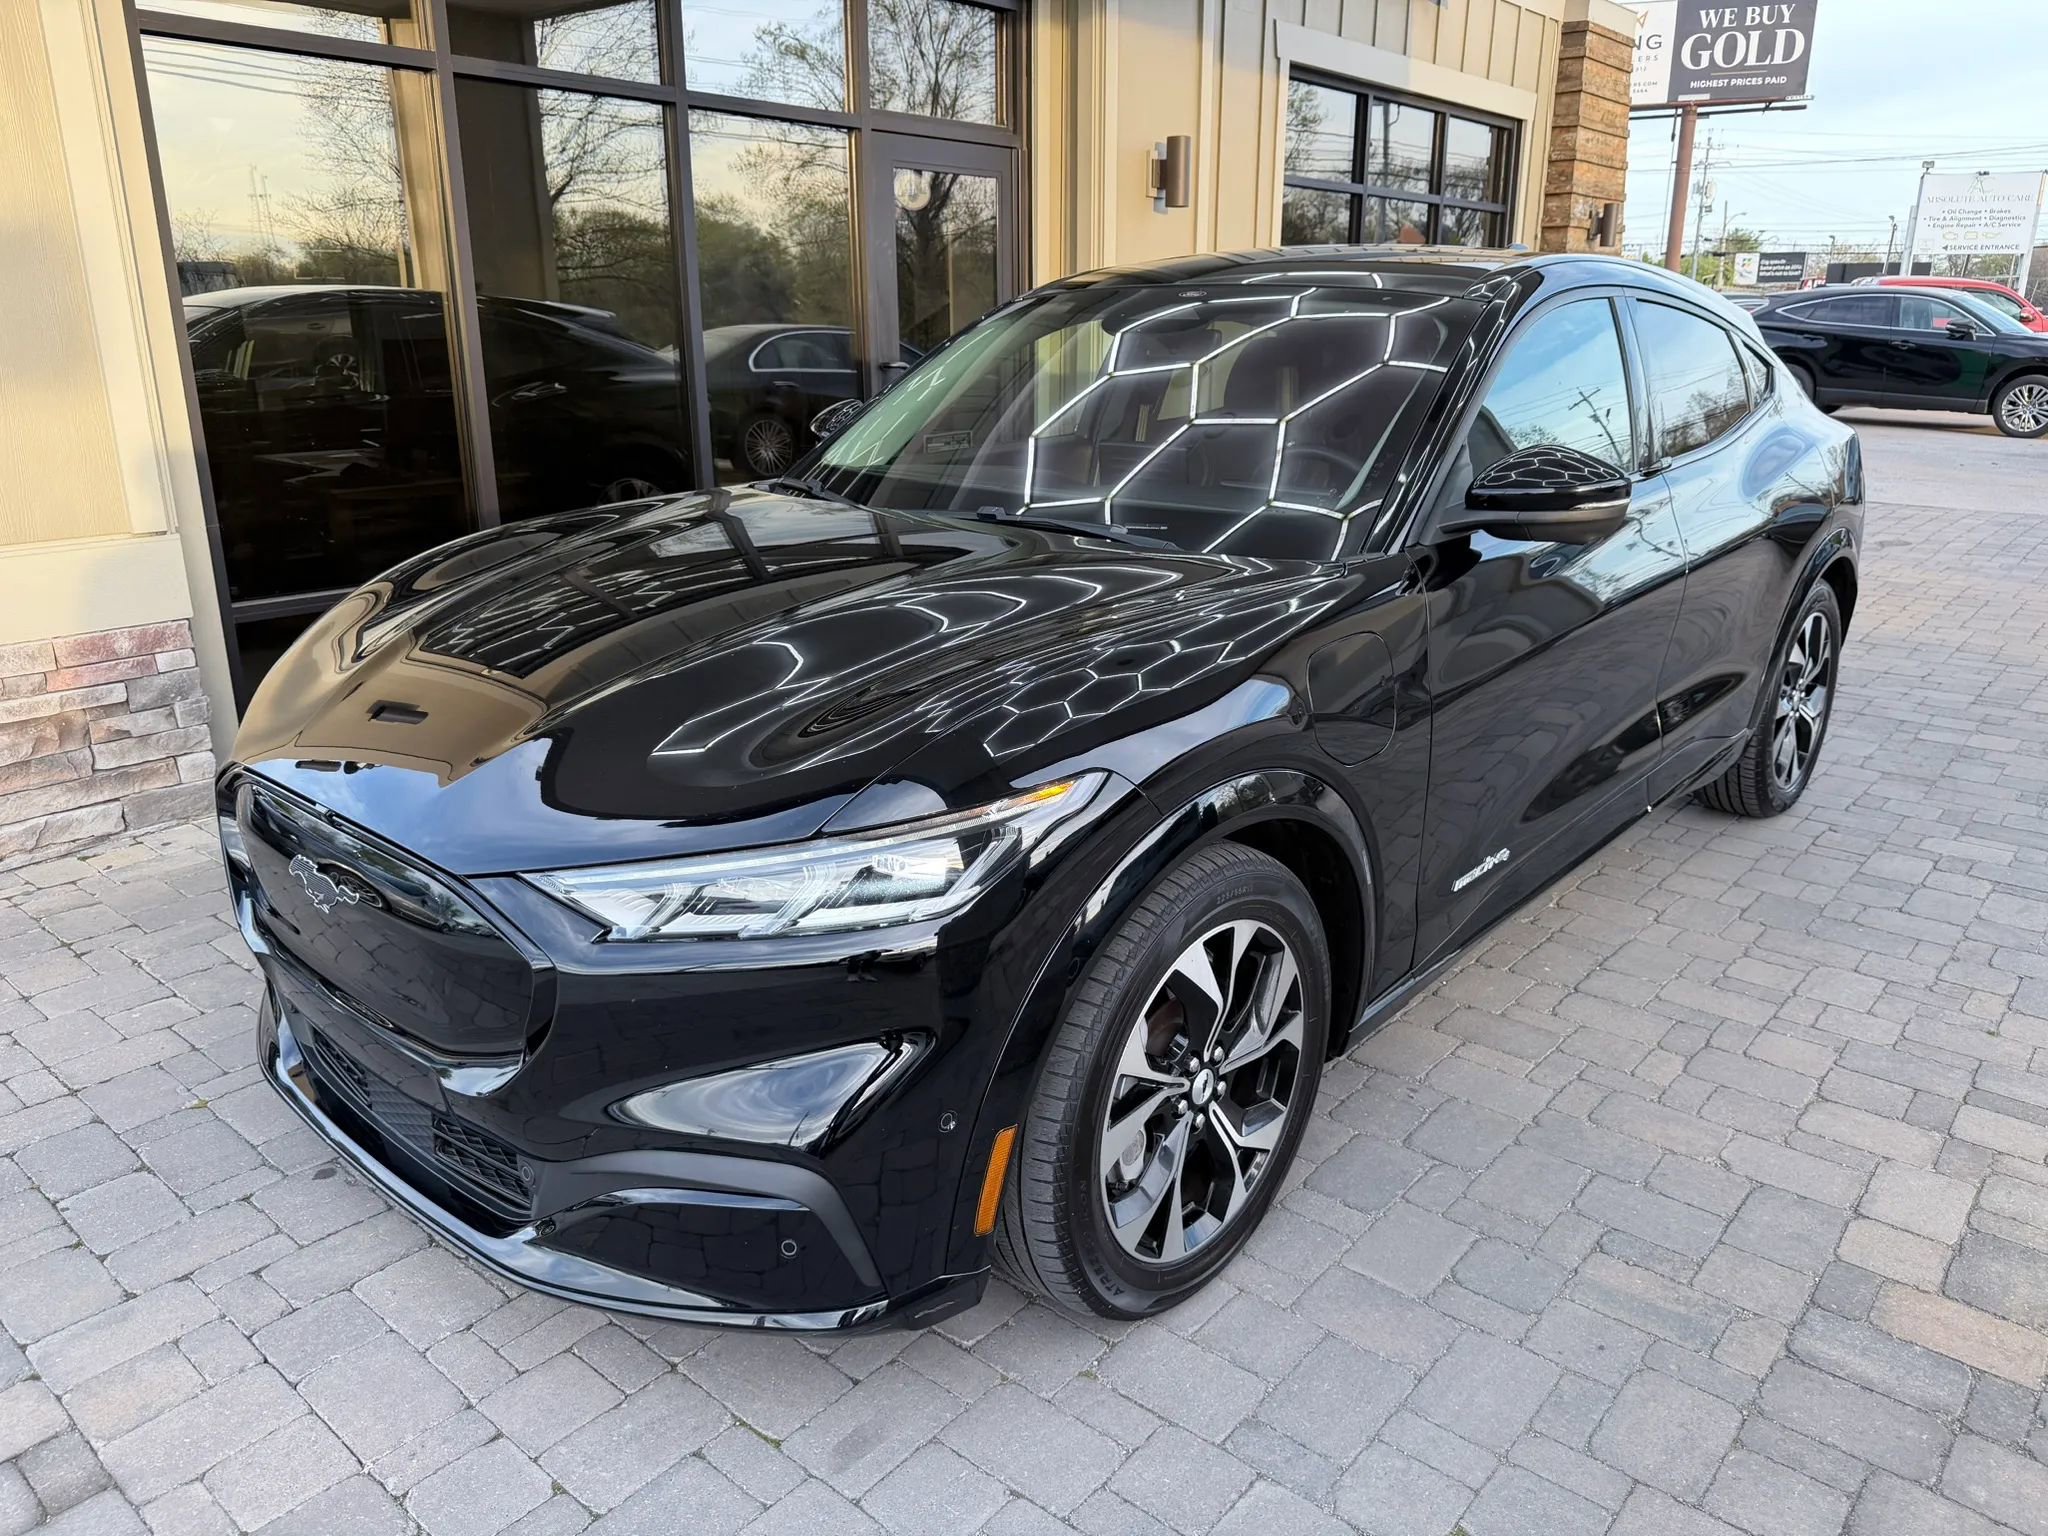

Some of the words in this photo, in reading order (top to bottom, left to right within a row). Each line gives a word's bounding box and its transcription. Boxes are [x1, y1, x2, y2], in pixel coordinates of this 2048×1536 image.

[1699, 8, 1737, 29] WE
[1745, 4, 1796, 26] BUY
[1680, 28, 1805, 70] GOLD
[1690, 79, 1729, 89] HIGHEST
[1730, 77, 1763, 87] PRICES
[1765, 76, 1787, 85] PAID
